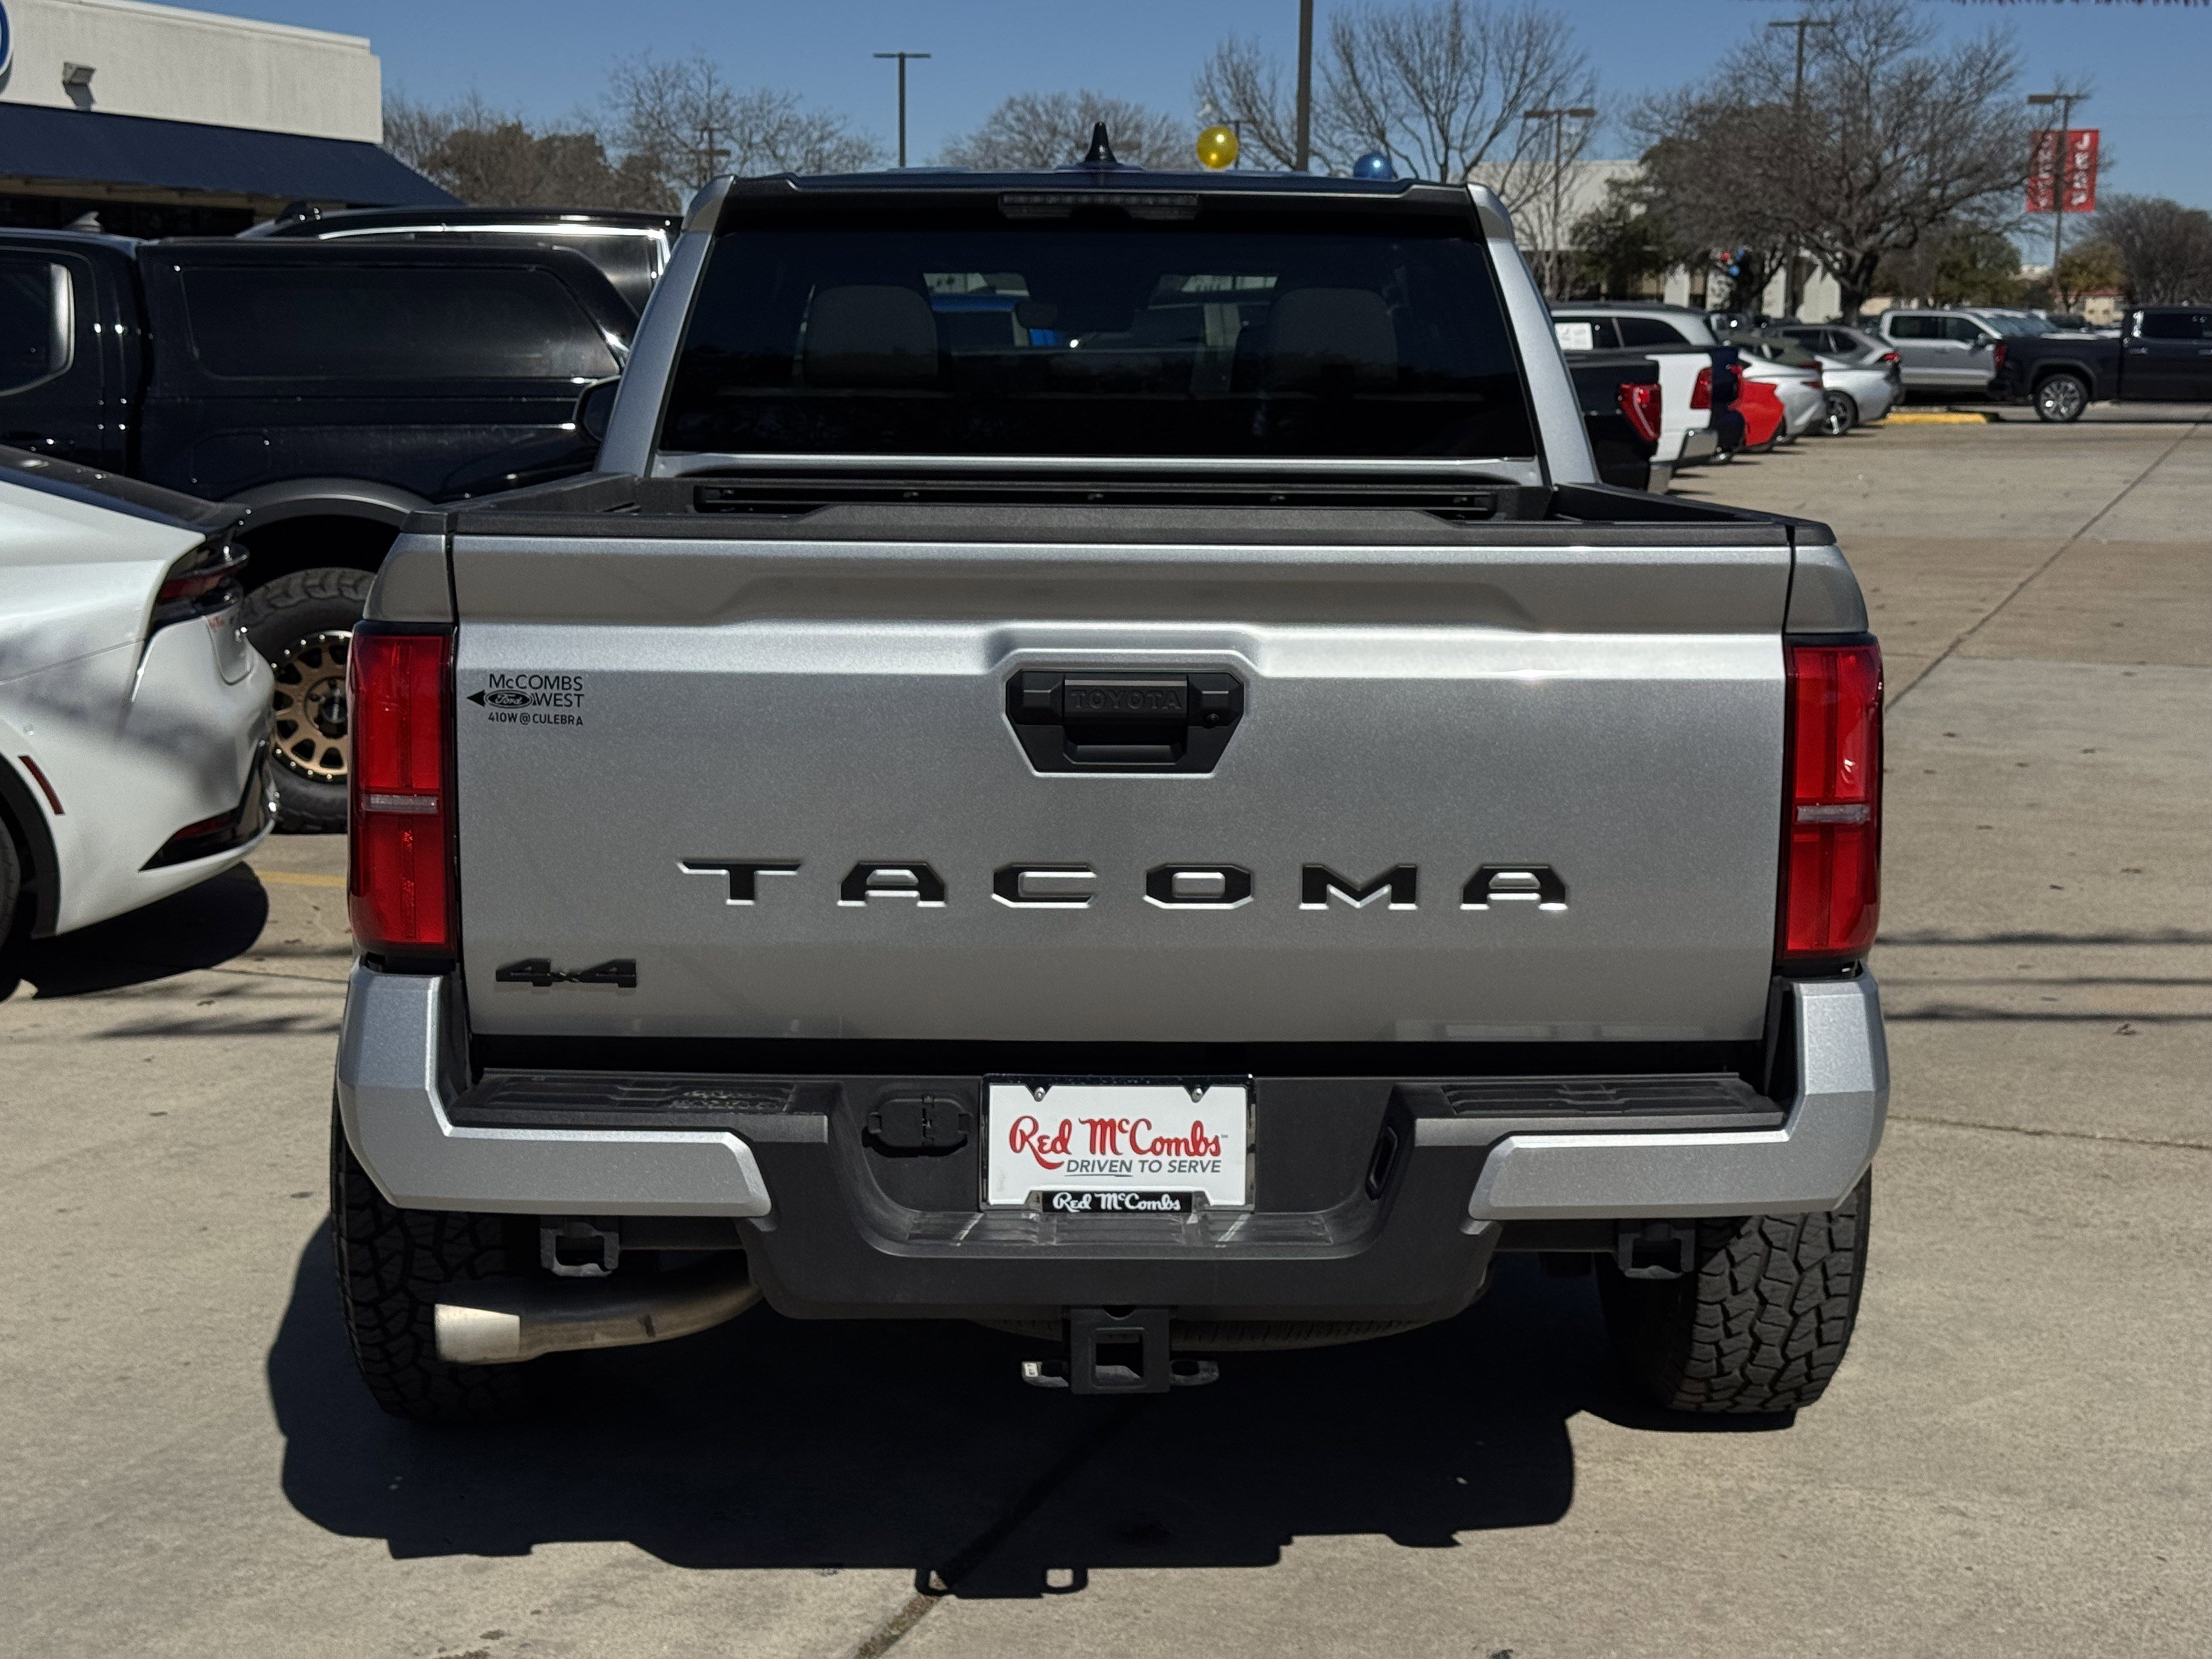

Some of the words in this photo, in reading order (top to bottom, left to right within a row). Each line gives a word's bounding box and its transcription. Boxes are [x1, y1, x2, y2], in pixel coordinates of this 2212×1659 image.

[489, 673, 583, 691] McCOMBS
[534, 692, 585, 708] WEST
[1071, 689, 1182, 710] TOYOTA
[674, 859, 1568, 911] TACOMA
[1009, 1115, 1073, 1170] Red
[1079, 1118, 1222, 1156] McCombs
[1066, 1159, 1133, 1173] DRIVEN
[1138, 1159, 1163, 1173] TO
[1167, 1160, 1222, 1173] SERVE
[1052, 1191, 1092, 1213] Red
[1093, 1192, 1182, 1212] McCombs
